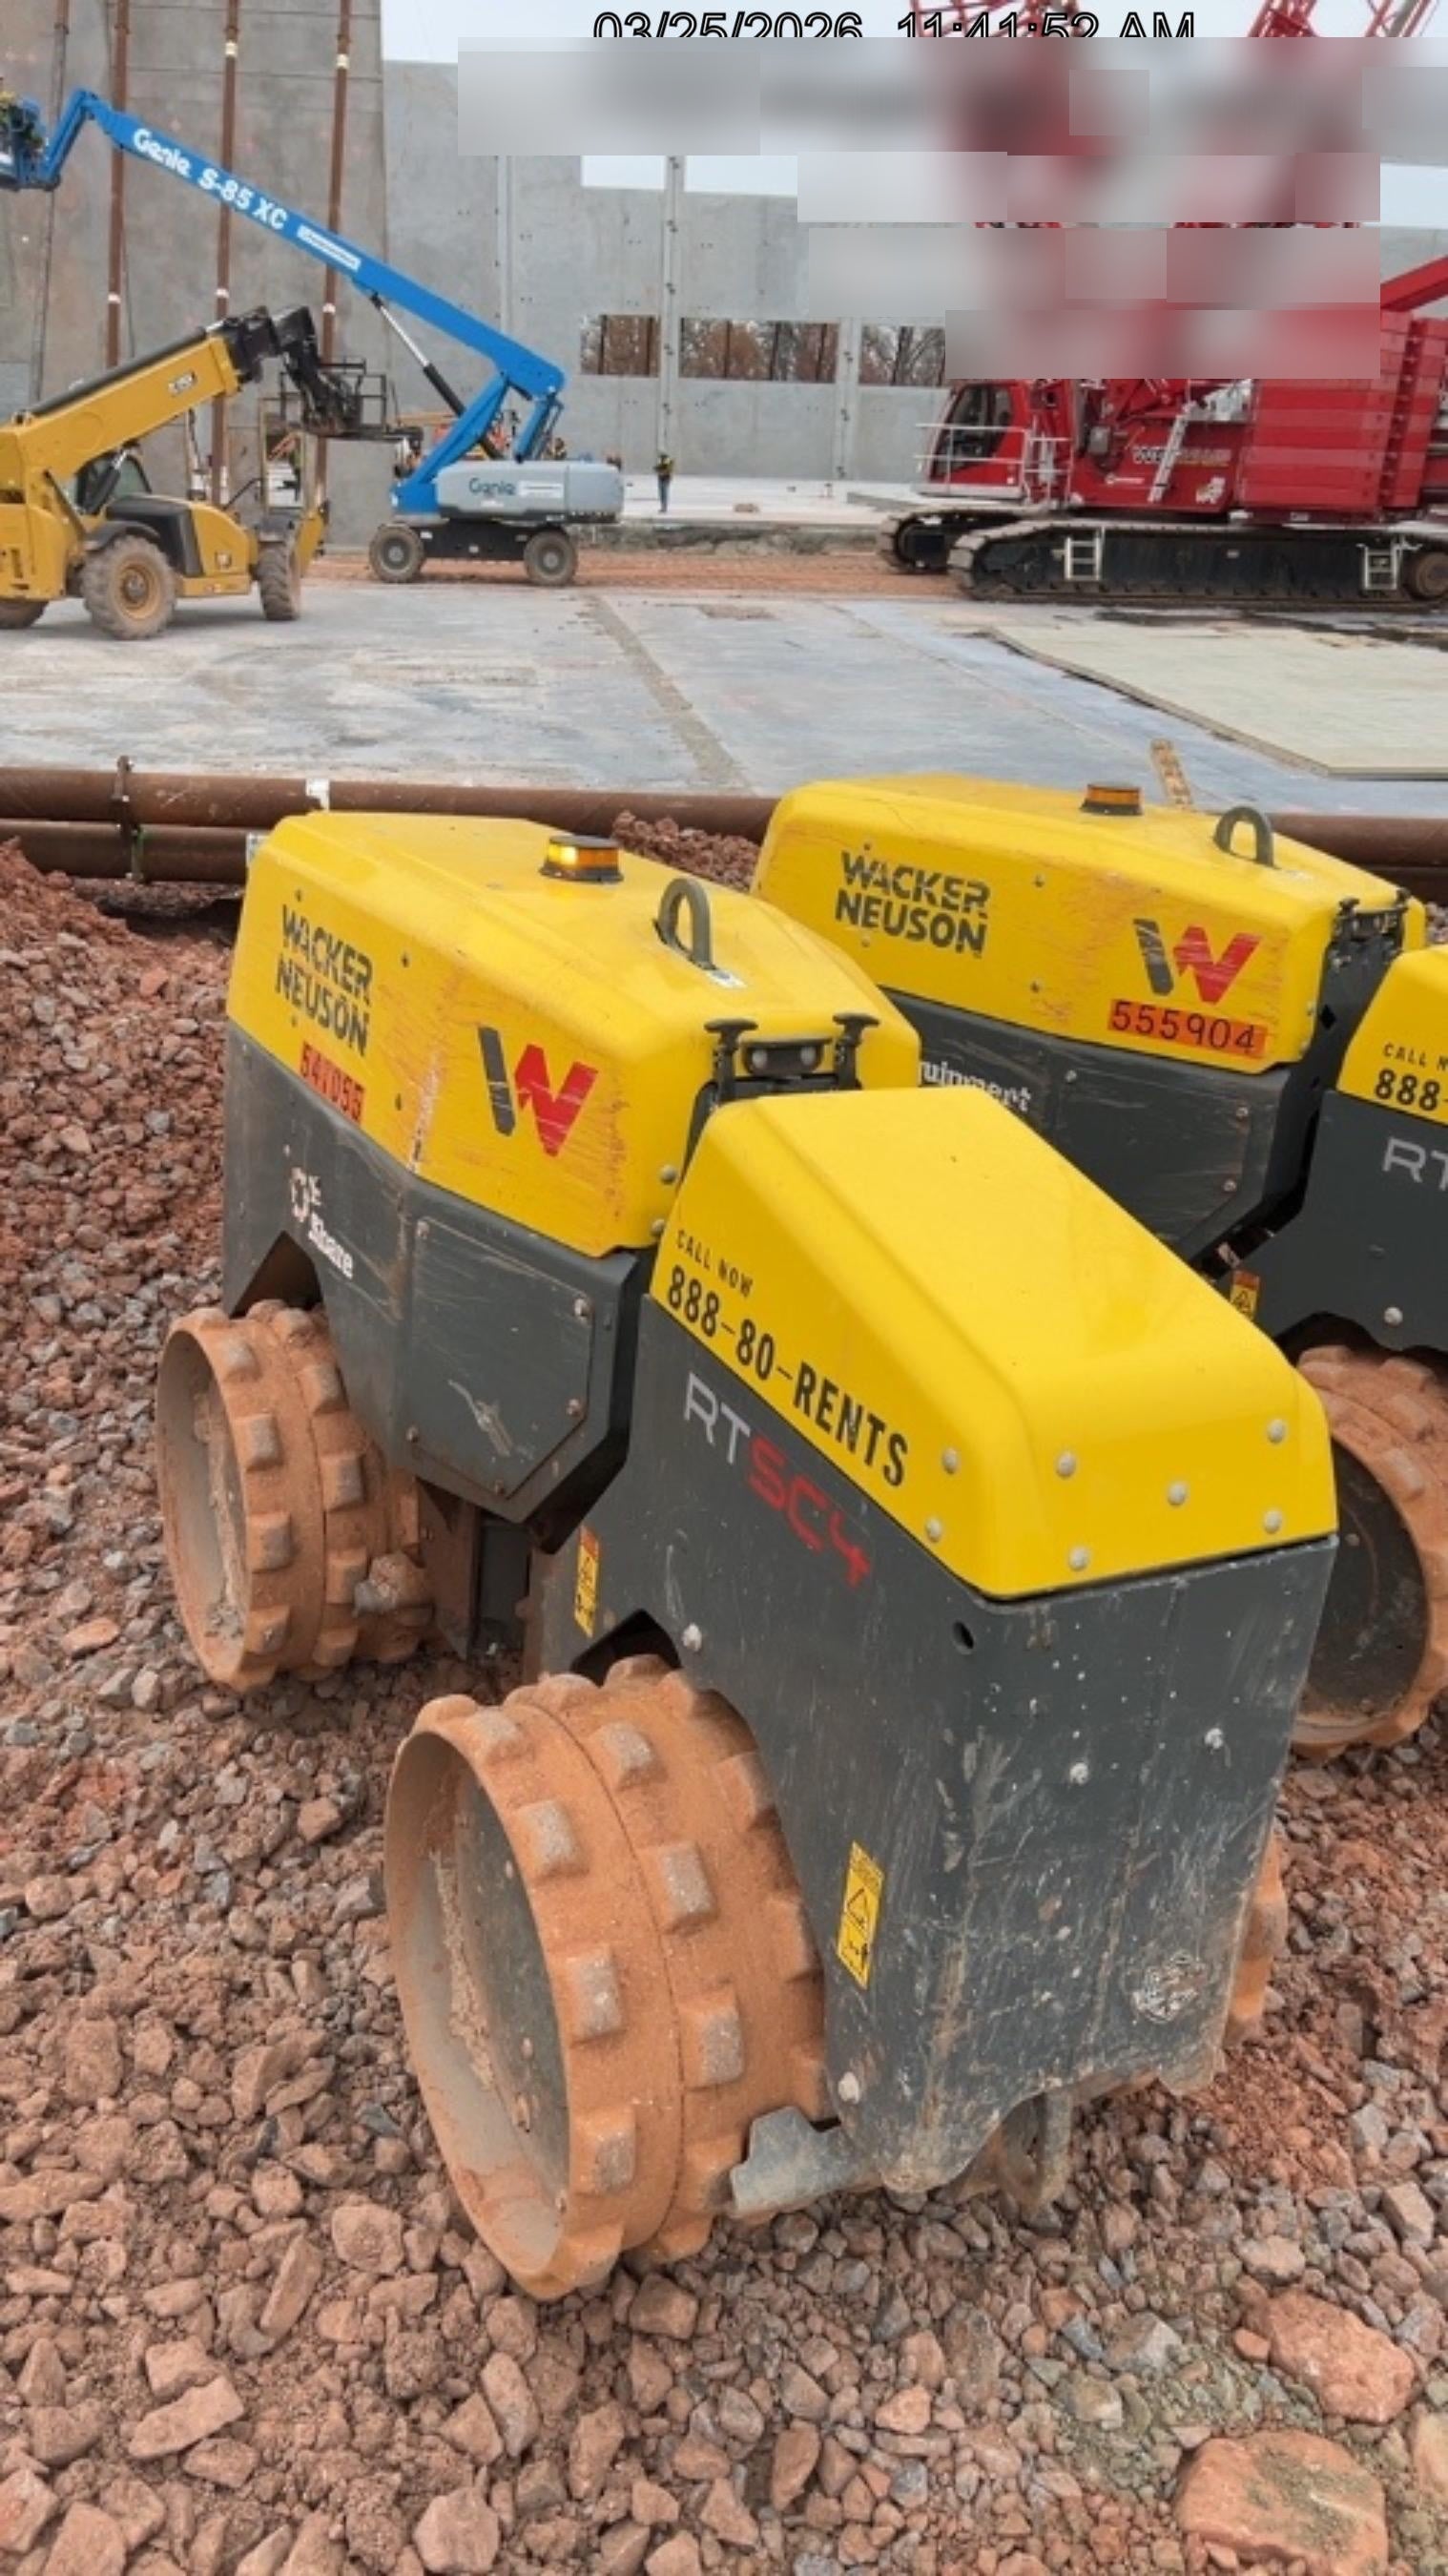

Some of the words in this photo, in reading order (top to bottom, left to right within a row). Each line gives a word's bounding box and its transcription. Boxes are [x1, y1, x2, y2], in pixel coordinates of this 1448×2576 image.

[134, 128, 192, 178] Genie
[197, 168, 254, 210] S-85
[253, 197, 288, 230] XC
[841, 850, 991, 920] WACKER
[282, 904, 373, 1006] WACKER
[836, 888, 986, 959] NEUSON
[276, 954, 370, 1058] NEUSON
[1111, 1001, 1257, 1055] 555904
[1383, 1042, 1428, 1068] CALL
[676, 1229, 711, 1271] CALL
[717, 1258, 754, 1298] NOW
[668, 1265, 909, 1487] 888-80-RENTS
